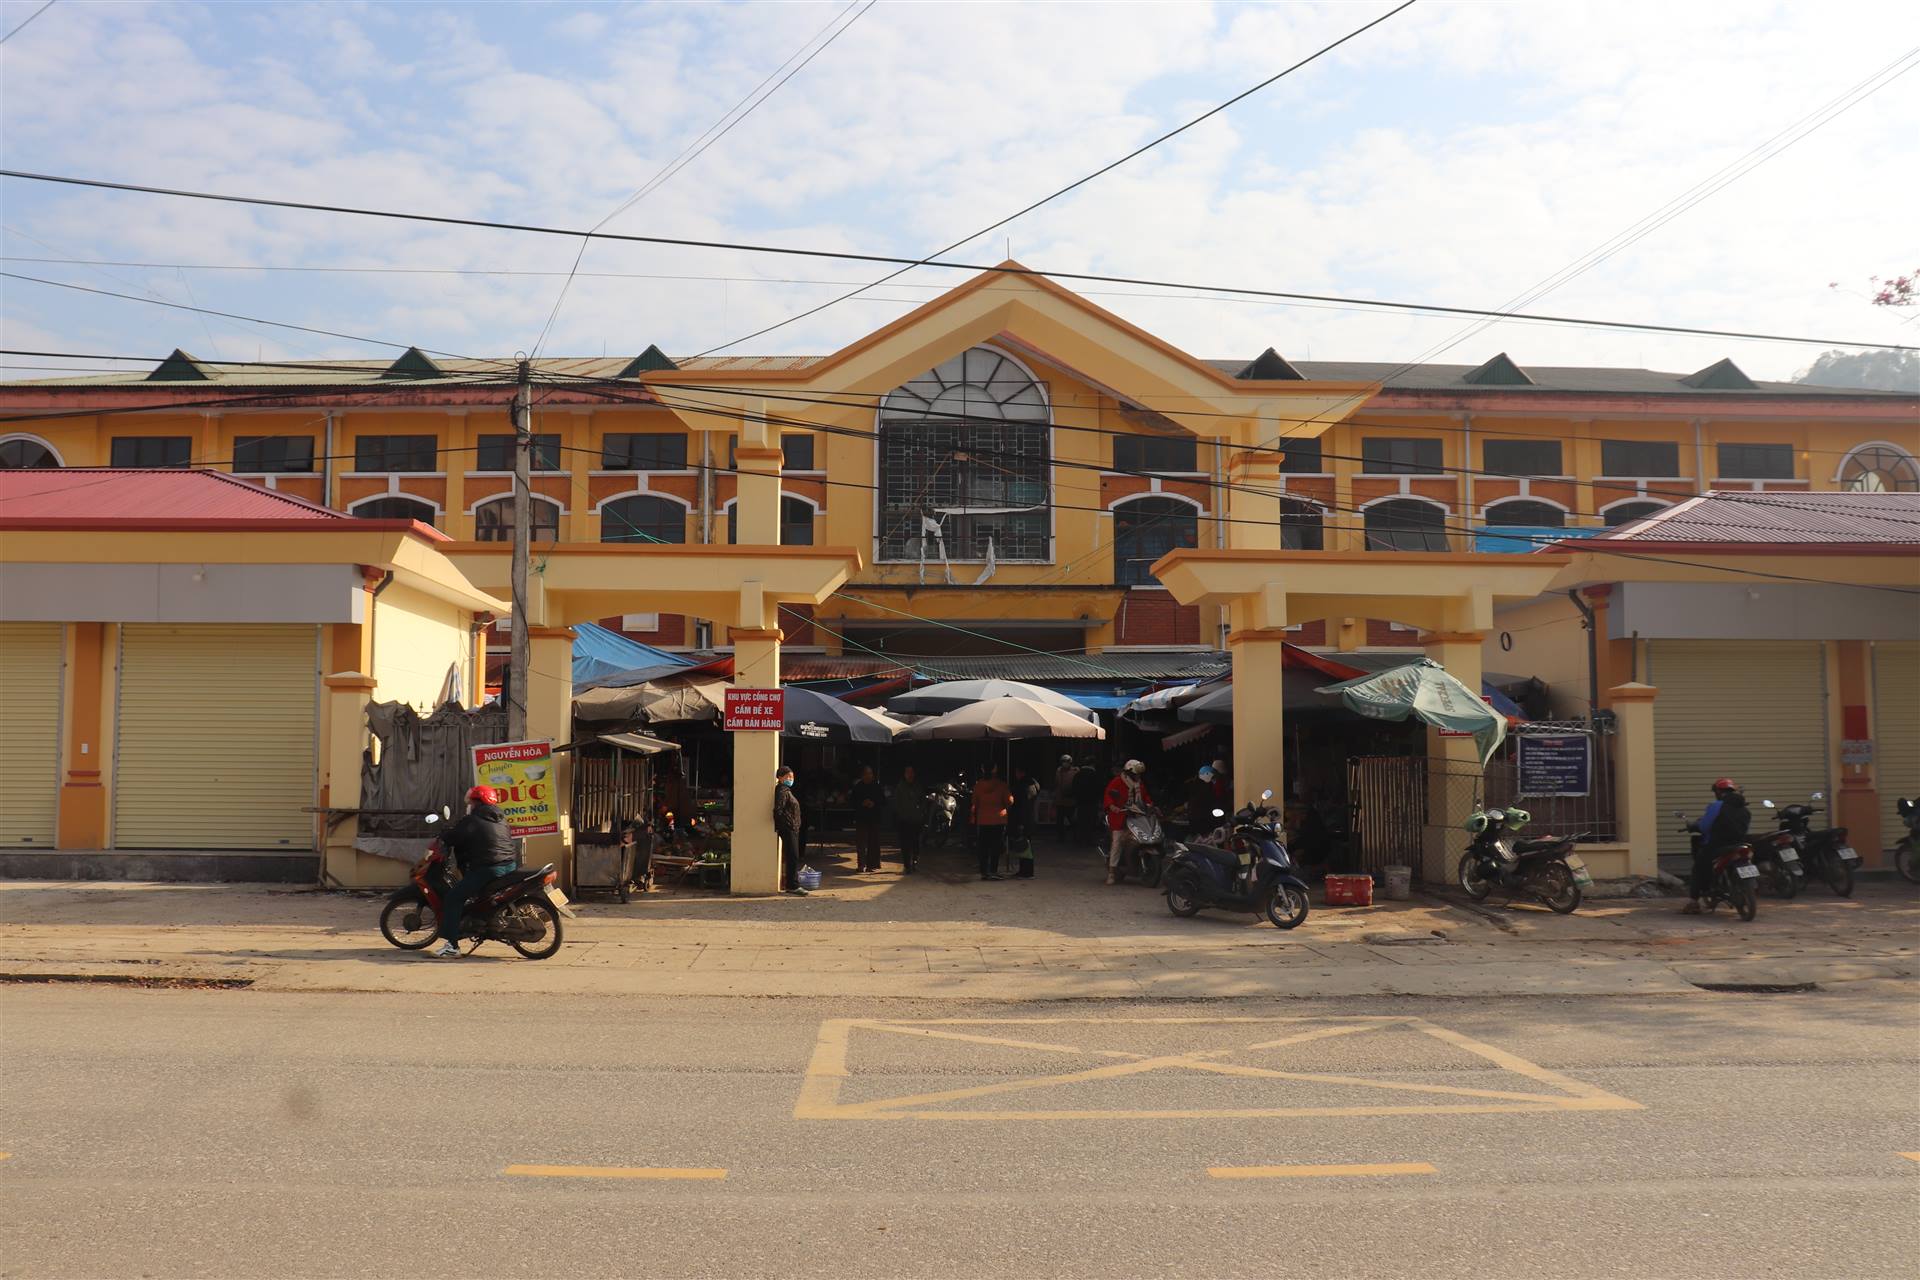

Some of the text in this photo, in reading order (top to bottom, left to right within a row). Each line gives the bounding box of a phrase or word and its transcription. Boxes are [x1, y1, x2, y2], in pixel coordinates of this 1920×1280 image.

[728, 693, 740, 701] KHU
[740, 692, 752, 702] VỰC
[769, 693, 781, 702] CHỢ
[735, 704, 752, 714] CẤM
[764, 706, 774, 714] XE
[726, 716, 782, 728] CẤM BÁN HÀNG
[484, 746, 542, 760] NGUYỄN HÒA
[504, 806, 526, 816] ONG
